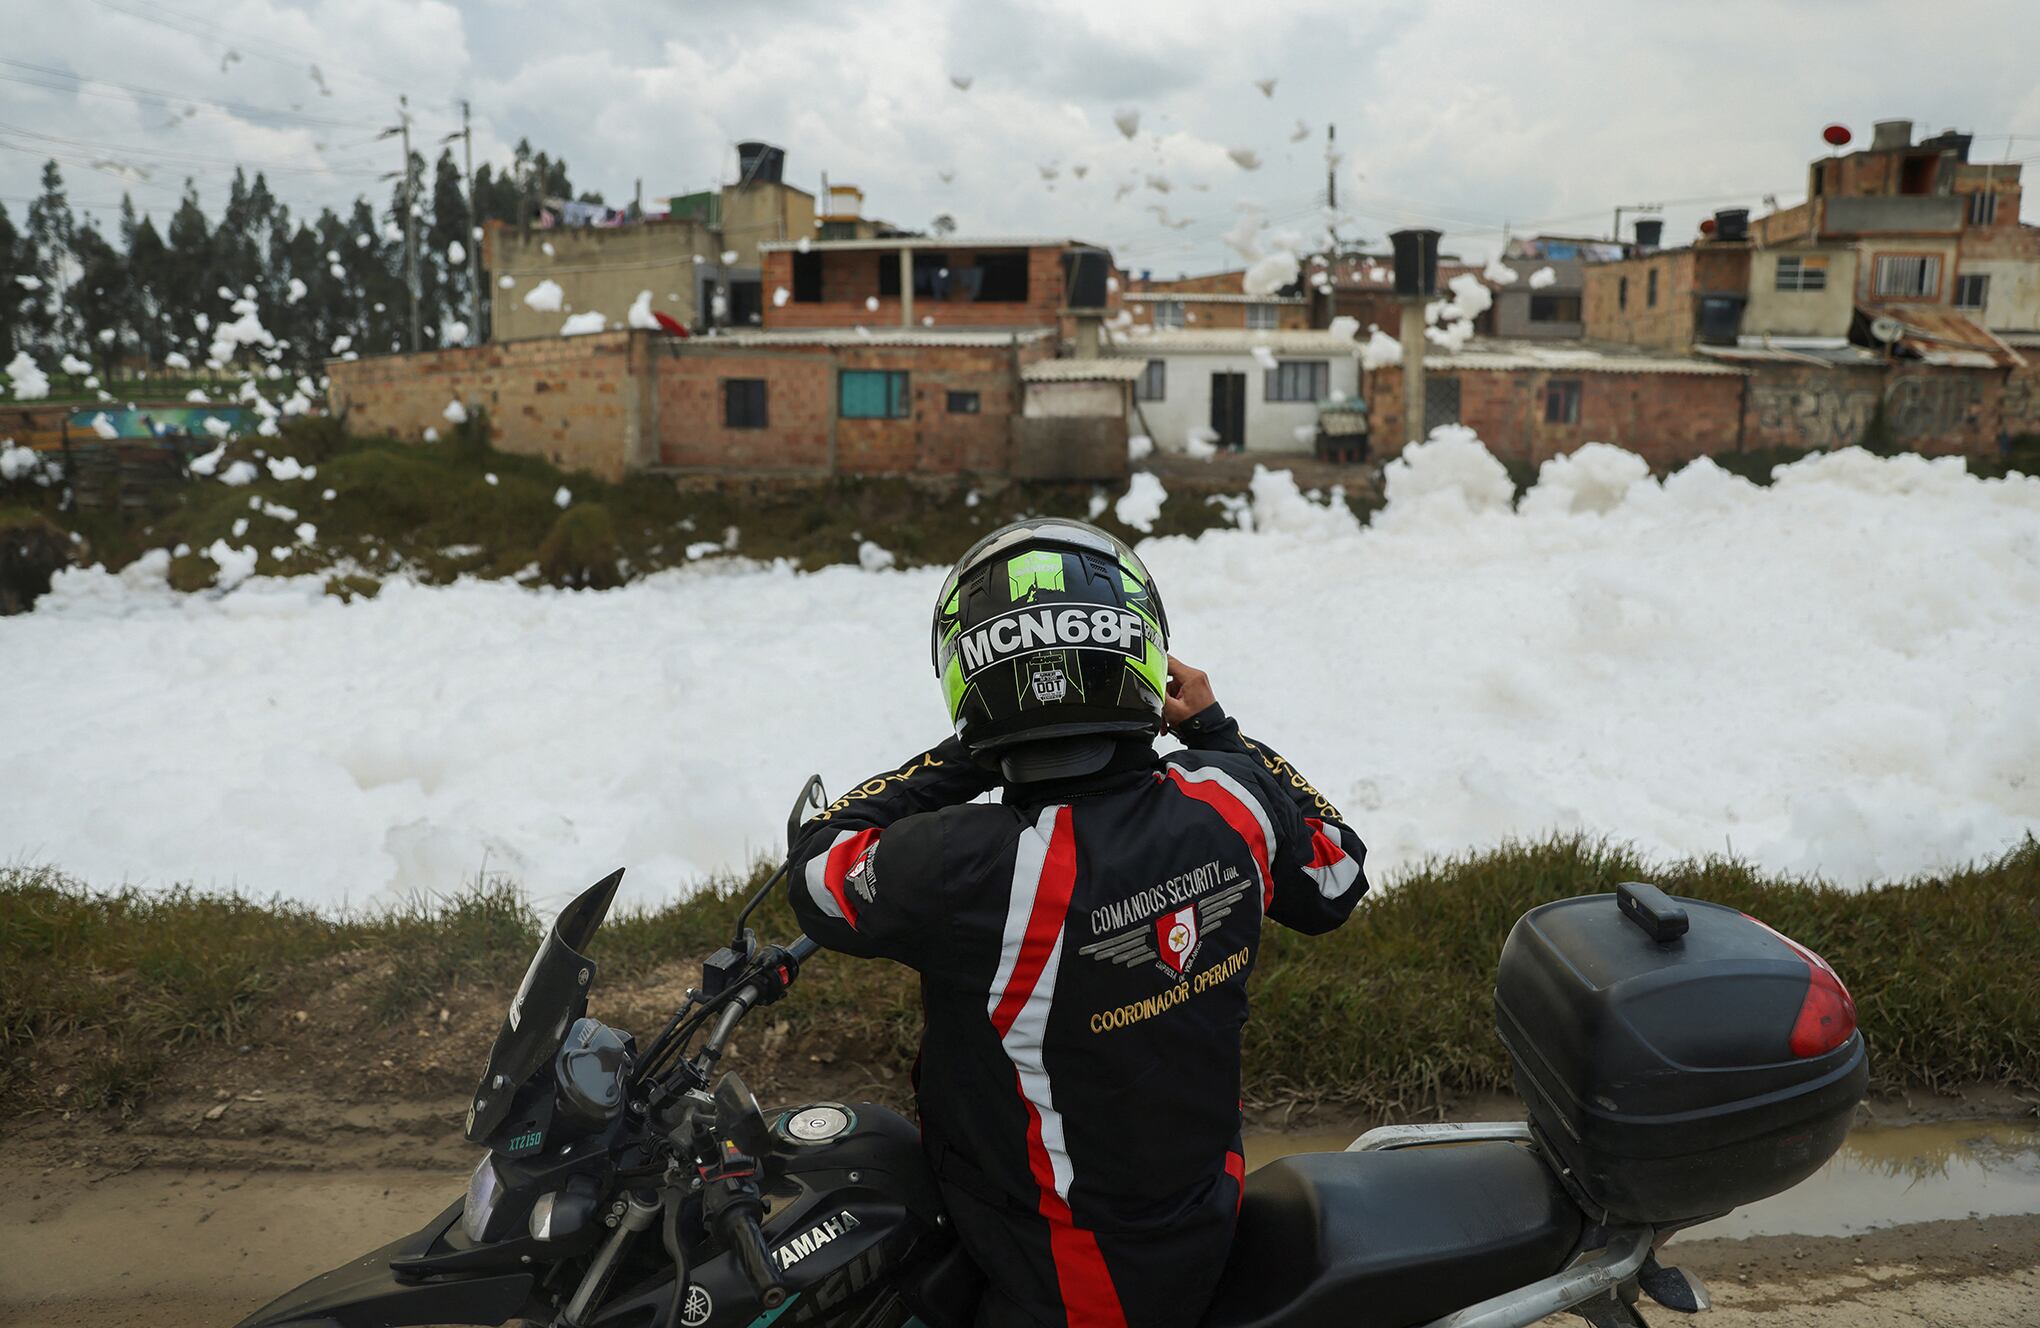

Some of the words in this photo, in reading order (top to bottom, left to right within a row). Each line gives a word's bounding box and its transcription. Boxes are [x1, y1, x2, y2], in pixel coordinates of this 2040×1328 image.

[960, 609, 1142, 671] MCN68F
[1037, 680, 1061, 693] DOT
[1091, 885, 1166, 936] COMANDOS
[1165, 860, 1222, 904] SECURITY
[1091, 981, 1189, 1034] COORDINADOR
[1193, 946, 1249, 994] OPERATIVO
